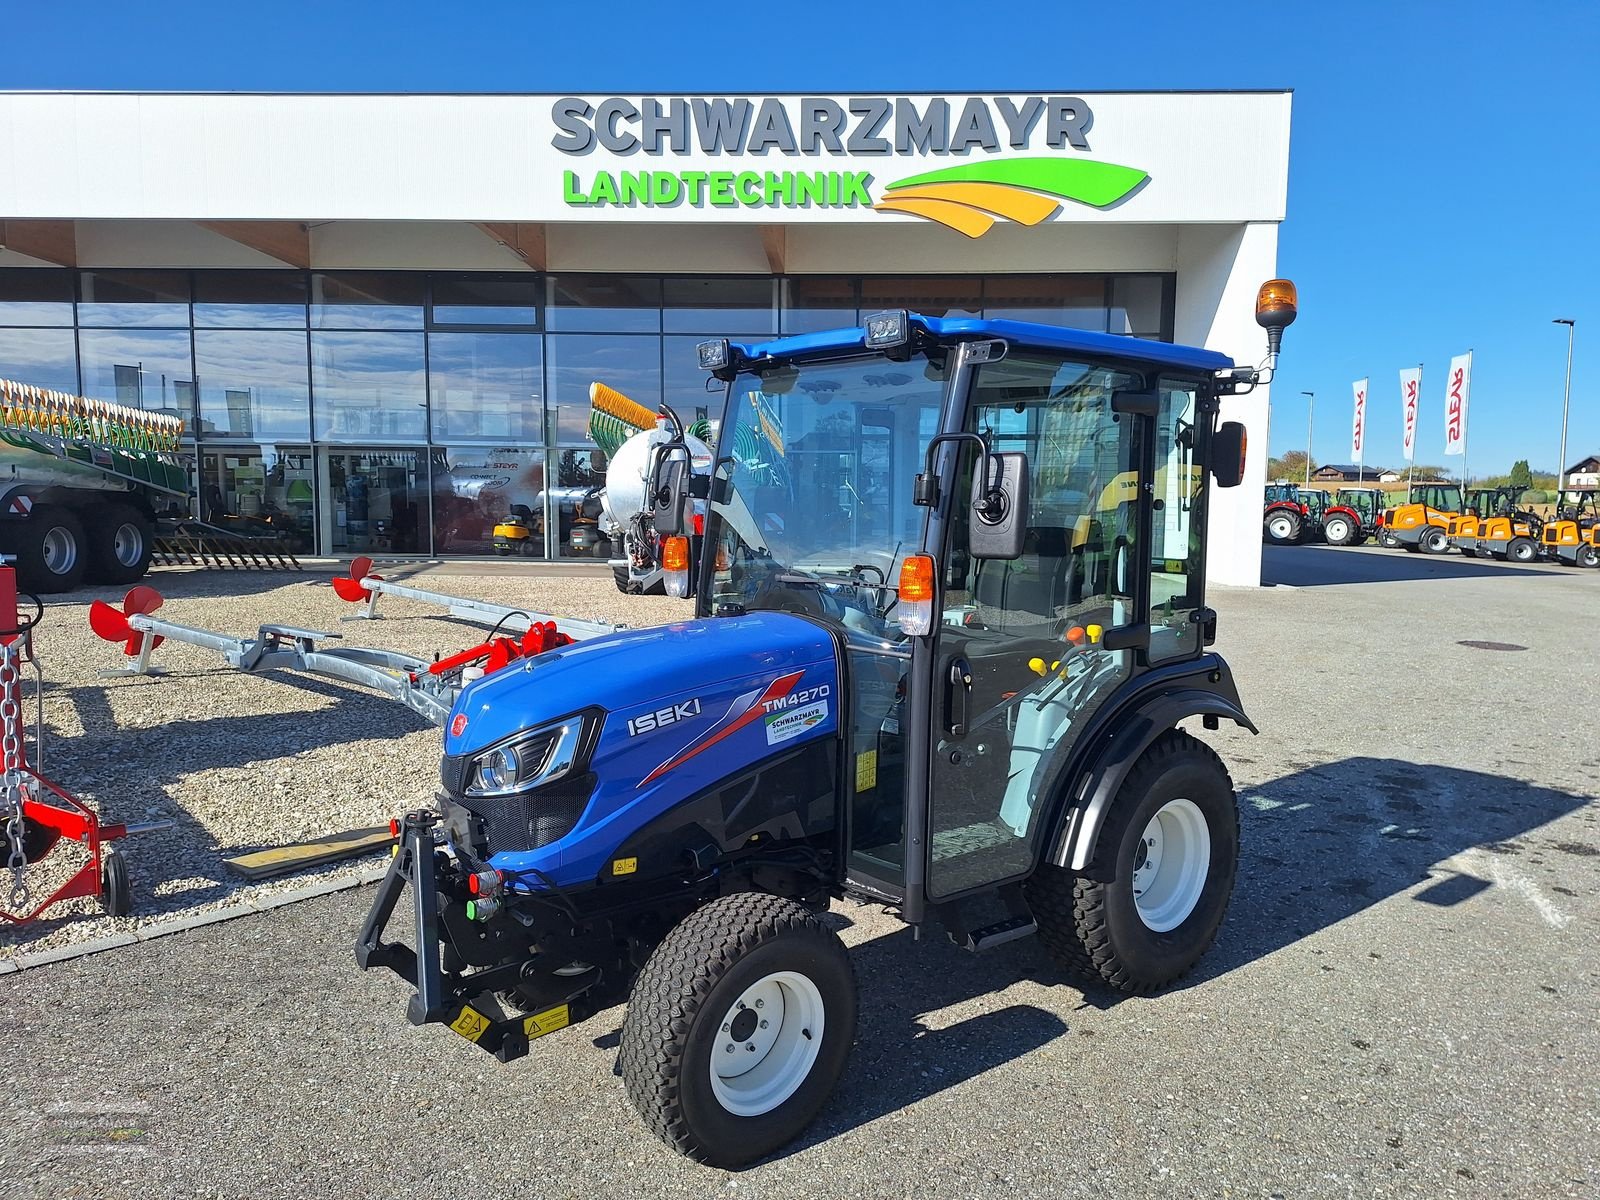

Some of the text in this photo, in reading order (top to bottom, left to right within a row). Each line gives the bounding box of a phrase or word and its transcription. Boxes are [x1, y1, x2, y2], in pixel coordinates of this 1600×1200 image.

[551, 97, 1093, 156] SCHWARZMAYR
[563, 169, 875, 208] LANDTECHNIK
[627, 698, 702, 737] ISEKI
[761, 684, 830, 713] TM4270
[771, 708, 820, 729] SCHWARZMAYR
